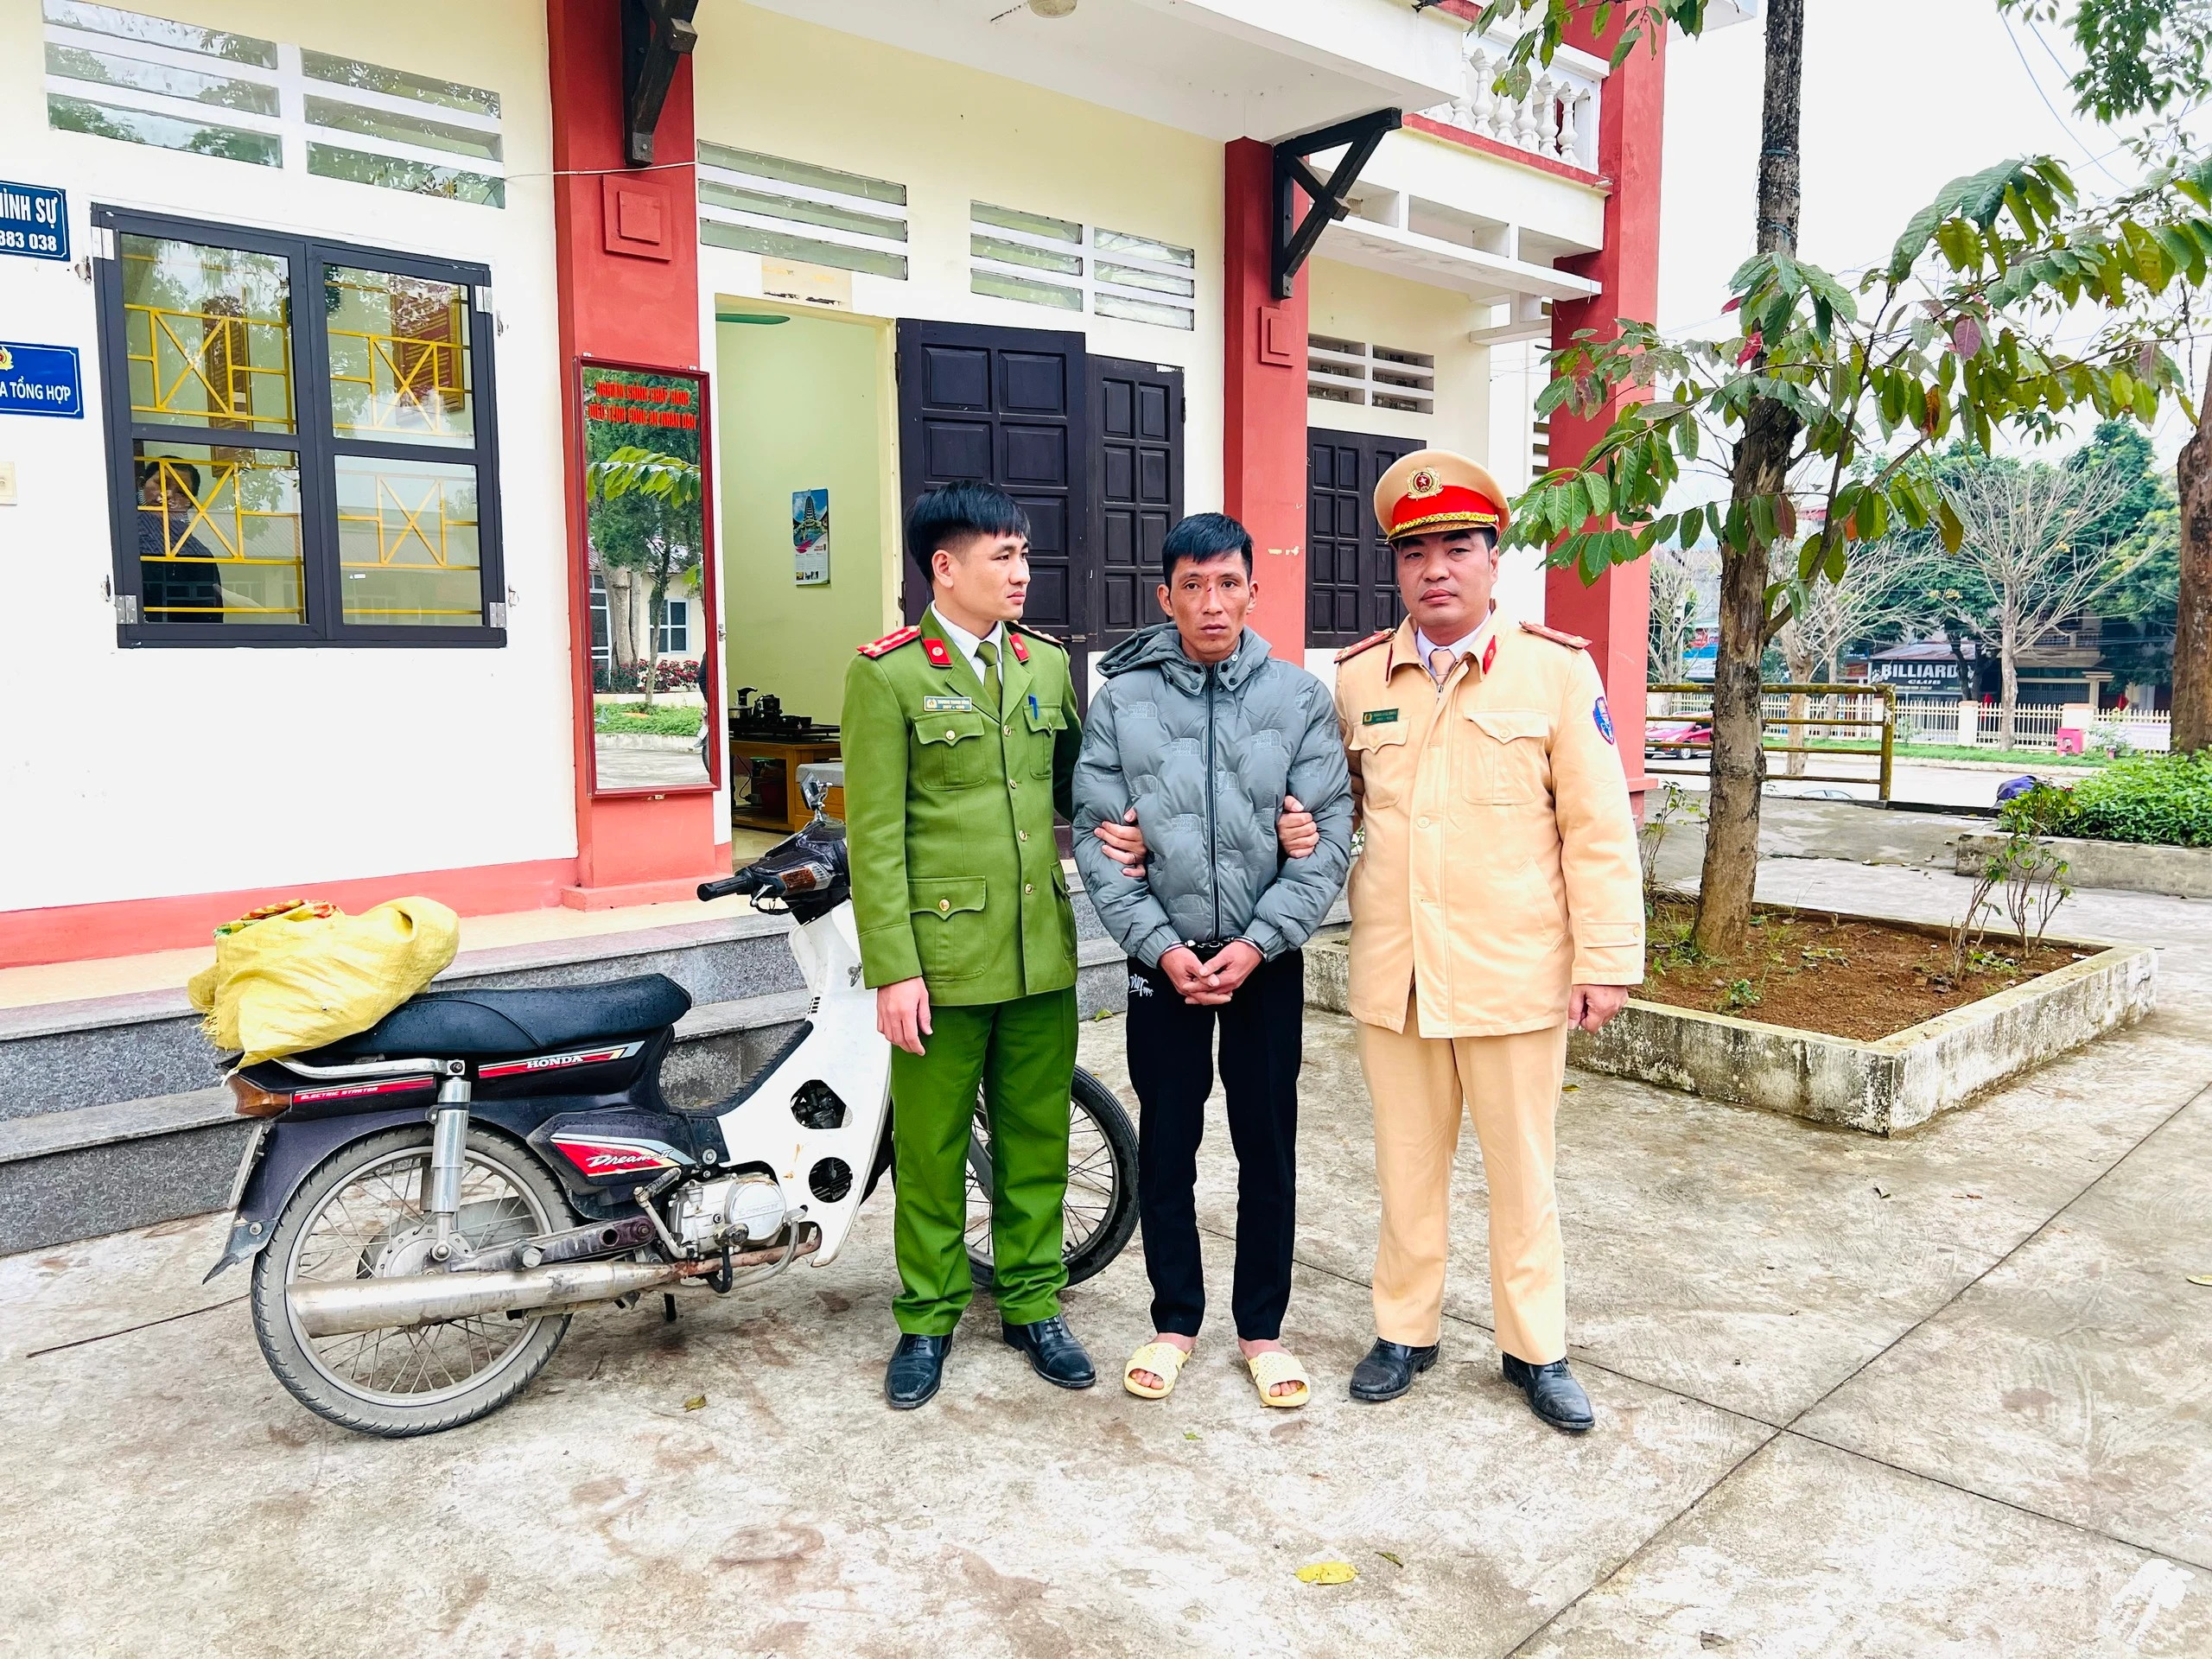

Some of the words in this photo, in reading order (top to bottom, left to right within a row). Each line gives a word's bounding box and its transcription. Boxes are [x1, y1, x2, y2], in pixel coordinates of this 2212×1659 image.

[35, 197, 58, 229] SỰ
[29, 233, 57, 251] 038
[10, 375, 43, 400] TỔNG
[46, 385, 71, 404] HỢP
[526, 1055, 583, 1069] HONDA
[301, 1090, 340, 1100] ELECTRIC
[341, 1086, 378, 1096] STARTER
[585, 1154, 655, 1167] Dream
